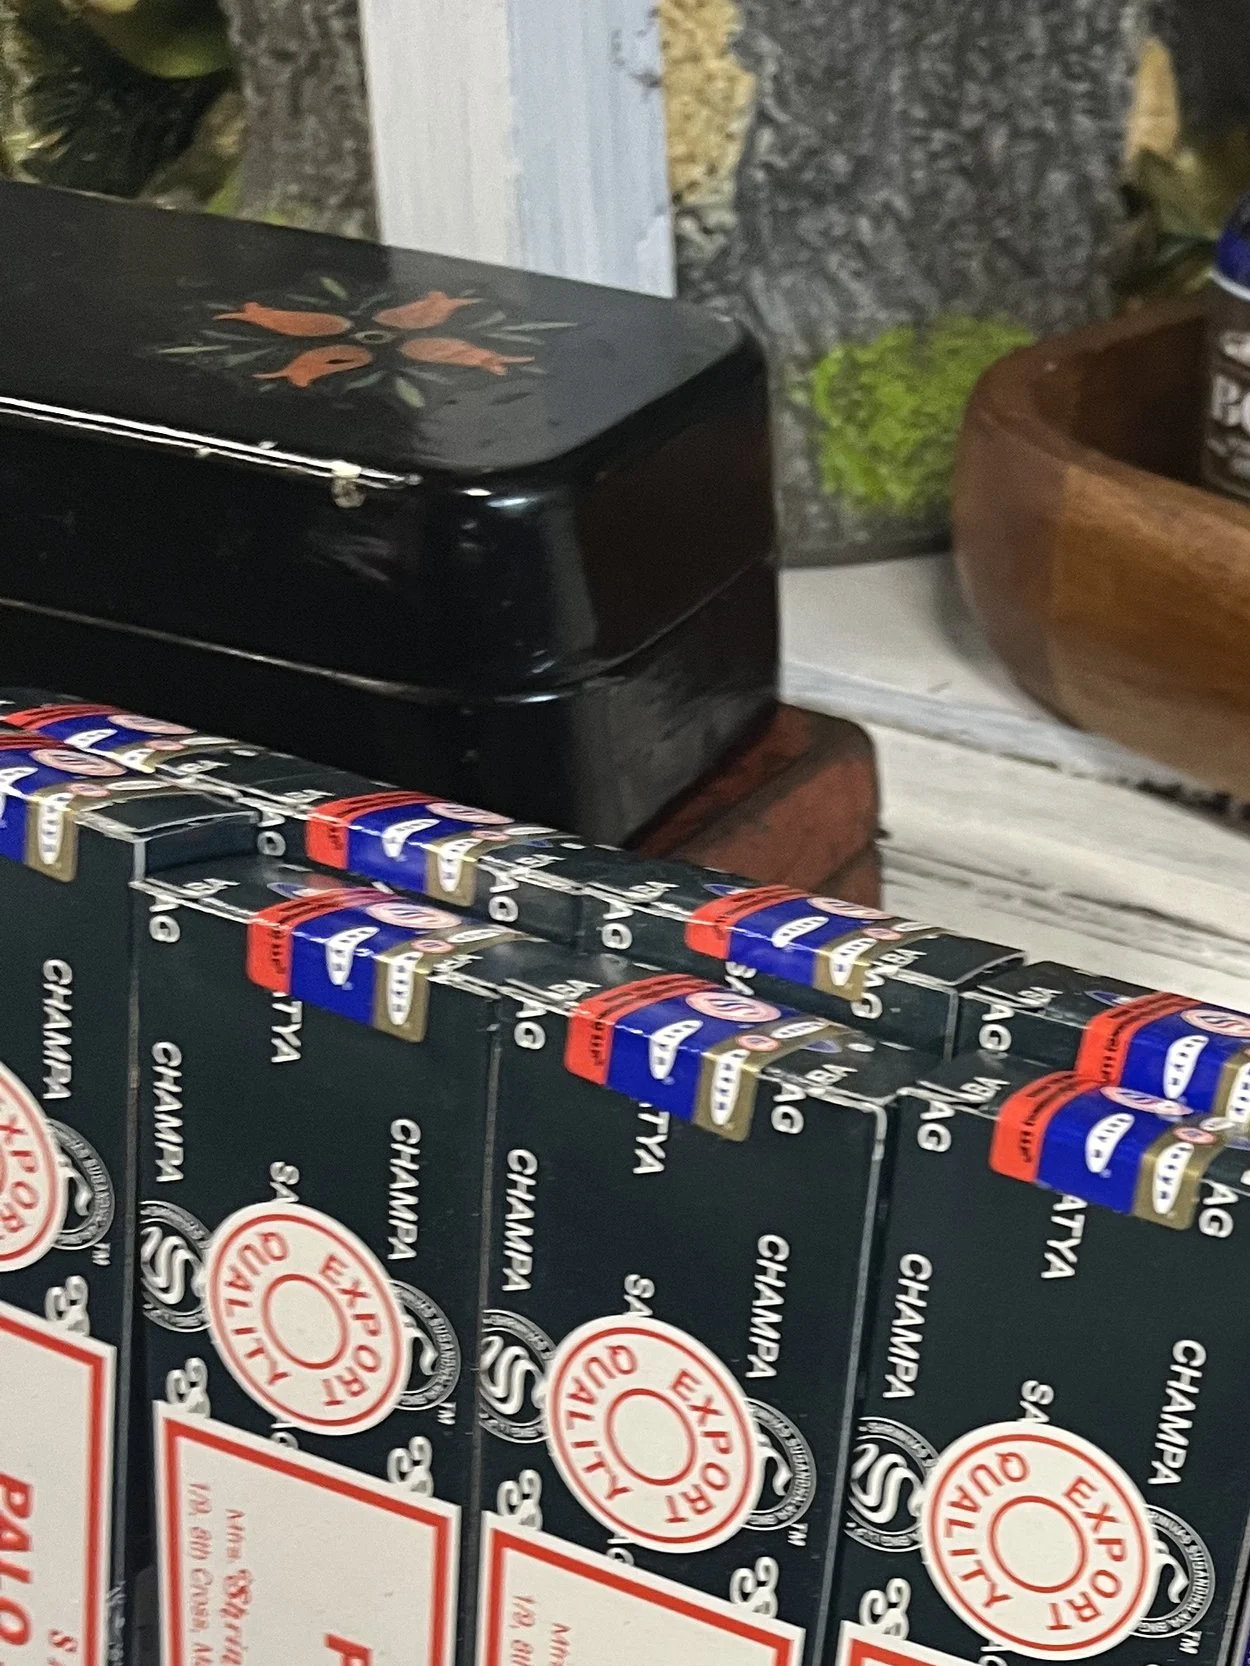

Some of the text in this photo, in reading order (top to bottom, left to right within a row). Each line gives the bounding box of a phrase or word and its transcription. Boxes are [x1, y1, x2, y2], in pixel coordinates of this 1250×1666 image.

[42, 958, 73, 1101] CHAMPA
[151, 1040, 185, 1183] CHAMPA
[386, 1118, 422, 1261] CHAMPA
[501, 1146, 537, 1292] CHAMPA
[223, 1230, 292, 1388] QUALITY
[318, 1252, 382, 1408] EXPORT
[744, 1232, 791, 1379] CHAMPA
[883, 1252, 934, 1400] CHAMPA
[565, 1343, 639, 1501] QUALITY
[665, 1367, 734, 1525] EXPORT
[1147, 1338, 1208, 1487] CHAMPA
[945, 1450, 1031, 1609] QUALITY
[1045, 1475, 1129, 1632] EXPORT
